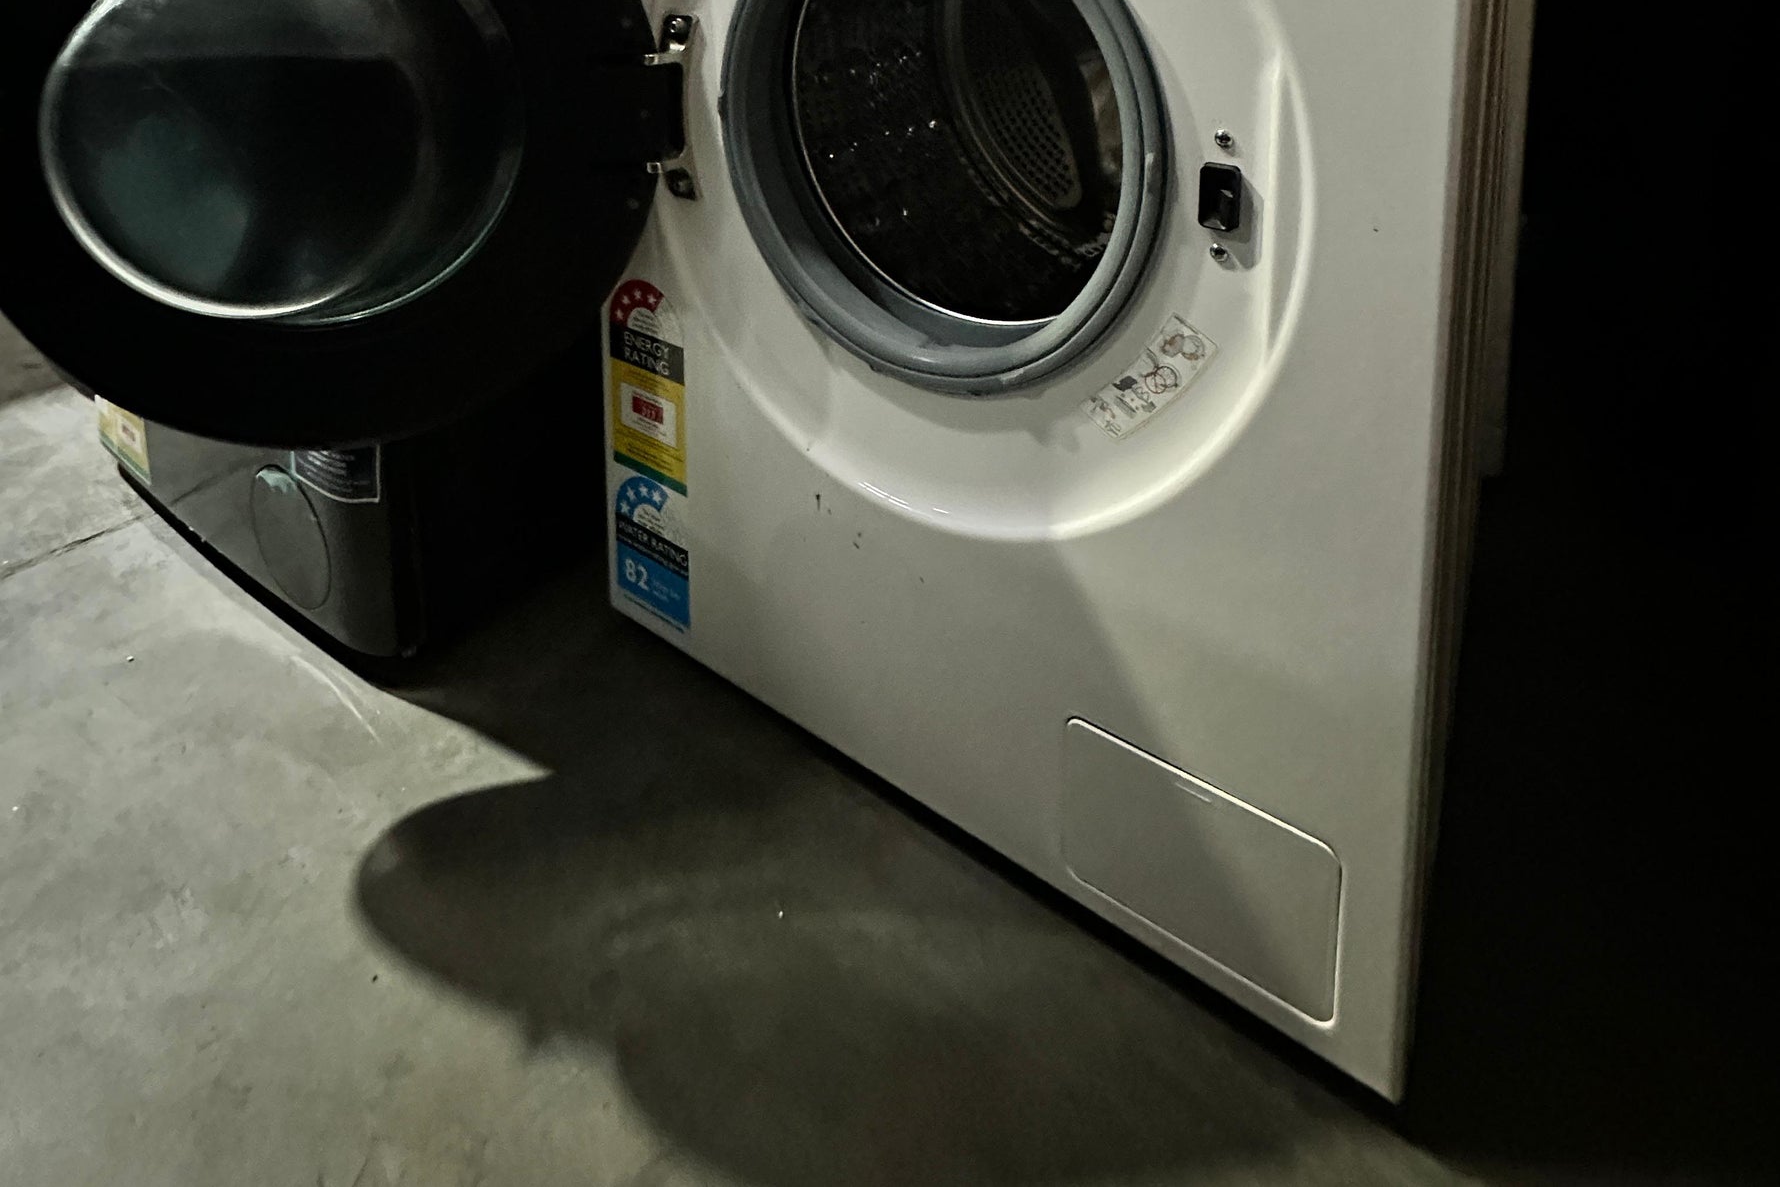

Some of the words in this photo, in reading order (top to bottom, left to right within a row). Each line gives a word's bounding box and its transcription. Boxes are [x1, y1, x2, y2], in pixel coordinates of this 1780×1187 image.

[624, 331, 670, 360] ENERGY
[624, 346, 670, 376] RATING
[618, 520, 650, 545] WATER
[650, 537, 688, 567] RATING
[624, 558, 650, 592] 82
